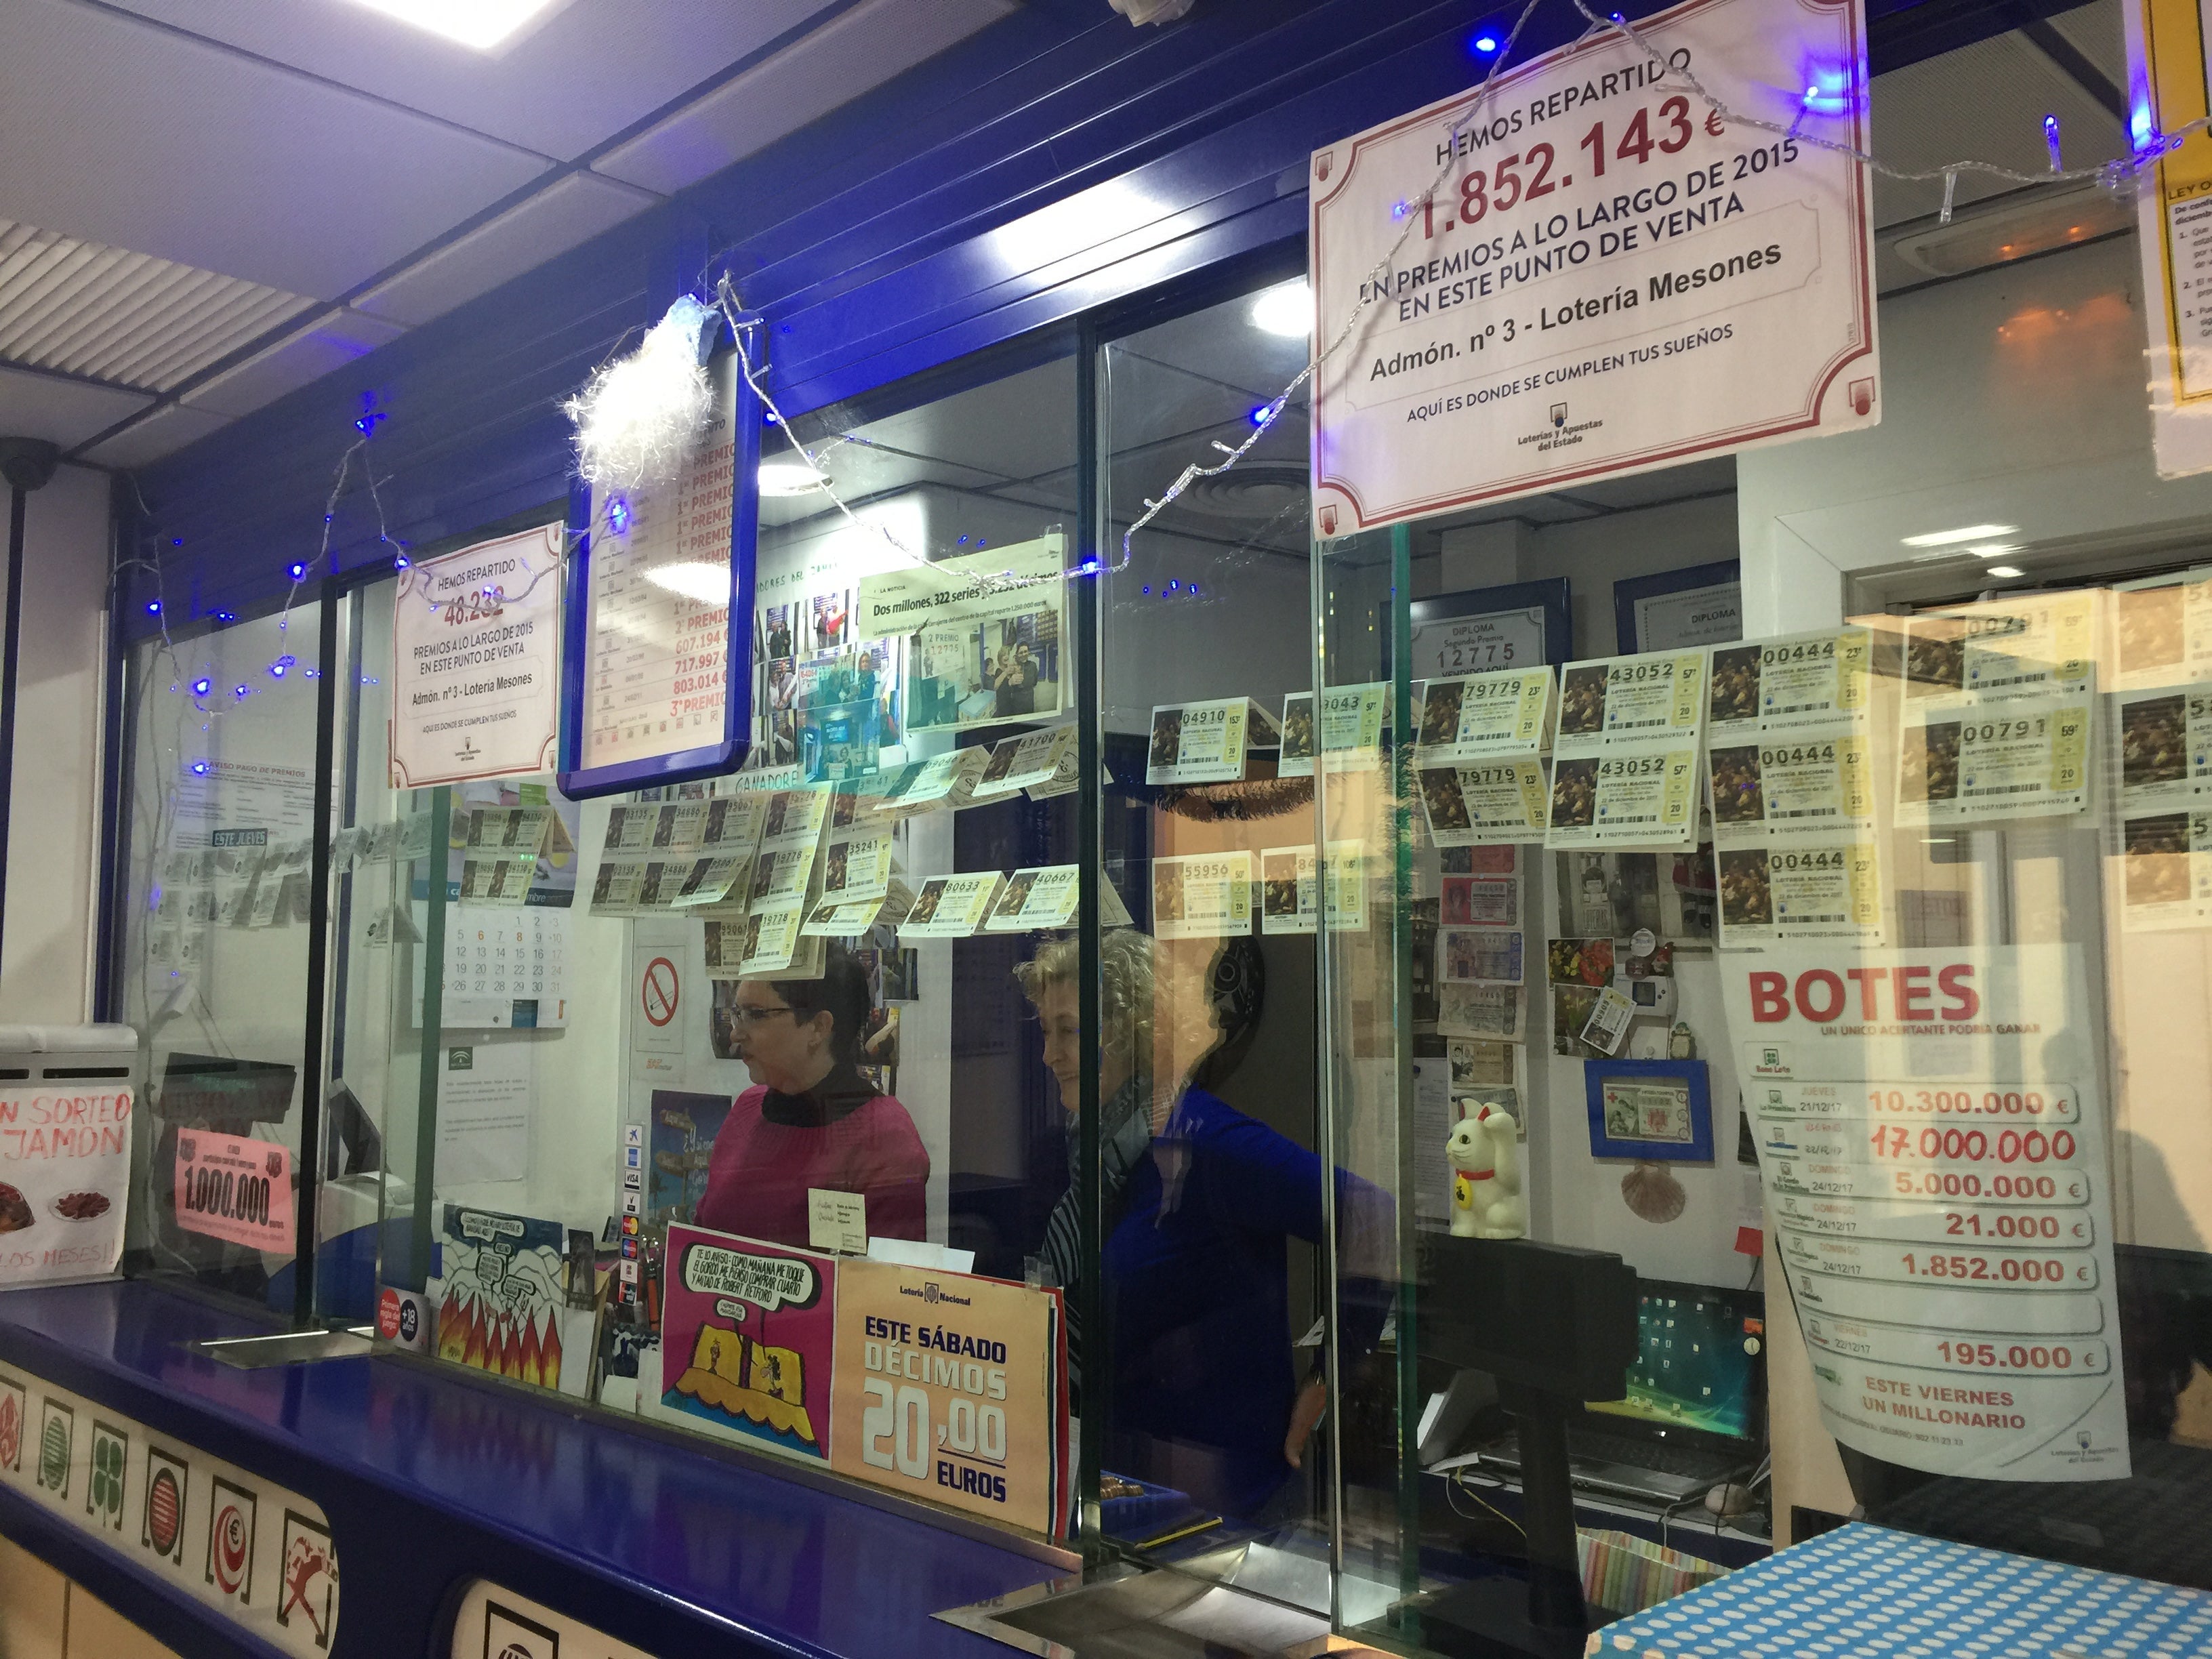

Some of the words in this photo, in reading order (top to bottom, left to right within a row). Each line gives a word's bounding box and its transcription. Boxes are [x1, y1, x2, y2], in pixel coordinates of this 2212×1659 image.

[1436, 110, 1522, 165] HEMOS
[1530, 48, 1691, 125] REPARTIDO
[1425, 95, 1693, 239] 1.852.143
[2169, 184, 2195, 200] LEY
[1397, 236, 1504, 294] PREMIOS
[1510, 230, 1528, 255] A
[1535, 214, 1568, 248] LO
[1578, 180, 1677, 230] LARGO
[1686, 161, 1723, 195] DE
[1733, 138, 1799, 181] 2015
[1399, 294, 1430, 323] EN
[1438, 272, 1492, 310] ESTE
[1500, 240, 1590, 289] PUNTO
[1600, 225, 1638, 258] DE
[1645, 190, 1744, 243] VENTA
[1370, 340, 1460, 381] Admón.
[1502, 319, 1515, 342] 3
[1540, 285, 1639, 330] Lotería
[1650, 243, 1782, 300] Mesones
[1407, 398, 1443, 422] AQUÍ
[1447, 396, 1462, 412] ES
[1467, 380, 1520, 407] DONDE
[1524, 375, 1541, 391] SE
[1544, 353, 1624, 385] CUMPLEN
[1629, 344, 1659, 365] TUS
[1664, 323, 1734, 356] SUEÑOS
[1517, 430, 1553, 445] Loterías
[1562, 419, 1603, 436] Apuestas
[1538, 443, 1551, 451] del
[1553, 434, 1583, 449] Estado
[438, 573, 466, 591] HEMOS
[466, 558, 516, 583] REPARTIDO
[874, 605, 890, 617] Dos
[892, 596, 933, 613] millones,
[935, 592, 950, 607] 322
[951, 587, 980, 602] series
[1692, 609, 1736, 623] DIPLOMA
[414, 640, 451, 659] PREMIOS
[452, 640, 457, 652] A
[459, 636, 469, 651] LO
[470, 629, 501, 647] LARGO
[503, 626, 514, 640] DE
[516, 621, 533, 637] 2015
[936, 634, 959, 642] PREMIO
[1452, 623, 1495, 636] DIPLOMA
[676, 630, 720, 655] 607.194
[1437, 642, 1515, 668] 12775
[1763, 642, 1835, 663] 00444
[420, 661, 432, 675] EN
[433, 657, 452, 672] ESTE
[453, 651, 482, 668] PUNTO
[484, 647, 495, 662] DE
[497, 642, 525, 659] VENTA
[675, 651, 720, 675] 717.997
[674, 672, 718, 695] 803.014
[1610, 663, 1673, 681] 43052
[412, 689, 441, 706] Admón.
[453, 685, 458, 698] 3
[464, 678, 495, 696] Lotería
[497, 673, 533, 690] Mesones
[1467, 681, 1521, 698] 79779
[1183, 710, 1225, 724] 04910
[1963, 718, 2046, 741] 00791
[1601, 758, 1664, 775] 43052
[1762, 745, 1835, 765] 00444
[271, 768, 305, 777] PREMIOS
[1459, 769, 1515, 783] 79779
[849, 840, 878, 854] 35241
[1185, 865, 1228, 878] 55956
[1770, 852, 1844, 869] 00444
[946, 881, 980, 892] 80633
[1037, 872, 1075, 883] 40667
[764, 913, 788, 926] 19778
[457, 947, 466, 956] 12
[477, 947, 487, 957] 13
[496, 948, 506, 958] 14
[516, 949, 525, 958] 15
[534, 949, 544, 959] 16
[1748, 964, 1980, 1023] BOTES
[1822, 1026, 1837, 1036] UN
[1881, 1024, 1945, 1035] ACERTANTE
[1996, 1023, 2041, 1034] GANAR
[28, 1093, 131, 1125] SORTEO
[1800, 1102, 1841, 1112] 21/12/17
[1869, 1091, 2044, 1114] 10.300.000
[2057, 1099, 2069, 1113] €
[1871, 1124, 2076, 1163] 17.000.000
[627, 1173, 639, 1183] VISA
[1812, 1181, 1853, 1193] 24/12/17
[1896, 1171, 2056, 1199] 5.000.000
[2069, 1183, 2081, 1197] €
[184, 1166, 270, 1227] 1.000.000
[1818, 1220, 1857, 1231] 24/12/17
[1946, 1213, 2059, 1238] 21.000
[2072, 1223, 2085, 1237] €
[693, 1260, 699, 1272] EL
[700, 1262, 719, 1276] GORDO
[719, 1265, 729, 1279] ME
[729, 1267, 749, 1284] PIENSO
[749, 1272, 777, 1290] COMPRAR
[777, 1279, 801, 1296] CUARTO
[697, 1248, 703, 1258] TE
[704, 1250, 712, 1260] LO
[732, 1255, 747, 1267] COMO
[748, 1259, 775, 1276] MAÑANA
[776, 1264, 784, 1277] ME
[784, 1265, 805, 1283] TOQUE
[1823, 1261, 1861, 1274] 24/12/17
[1902, 1253, 2064, 1282] 1.852.000
[2077, 1267, 2089, 1281] €
[691, 1273, 697, 1284] Y
[714, 1277, 720, 1289] DE
[722, 1278, 744, 1295] ROBERT
[744, 1285, 773, 1303] RETFORD
[899, 1286, 924, 1298] Lotería
[939, 1292, 970, 1306] Nacional
[402, 1309, 415, 1323] +18
[865, 1315, 911, 1344] ESTE
[918, 1325, 1006, 1364] SÁBADO
[1835, 1338, 1870, 1353] 22/12/17
[1937, 1341, 2072, 1368] 195.000
[2084, 1353, 2095, 1368] €
[865, 1340, 1006, 1401] DÉCIMOS
[1865, 1376, 1911, 1397] ESTE
[1919, 1384, 2014, 1407] VIERNES
[1862, 1395, 1887, 1414] UN
[1892, 1401, 2026, 1429] MILLONARIO
[863, 1376, 1006, 1480] 20,00
[937, 1460, 1006, 1503] EUROS
